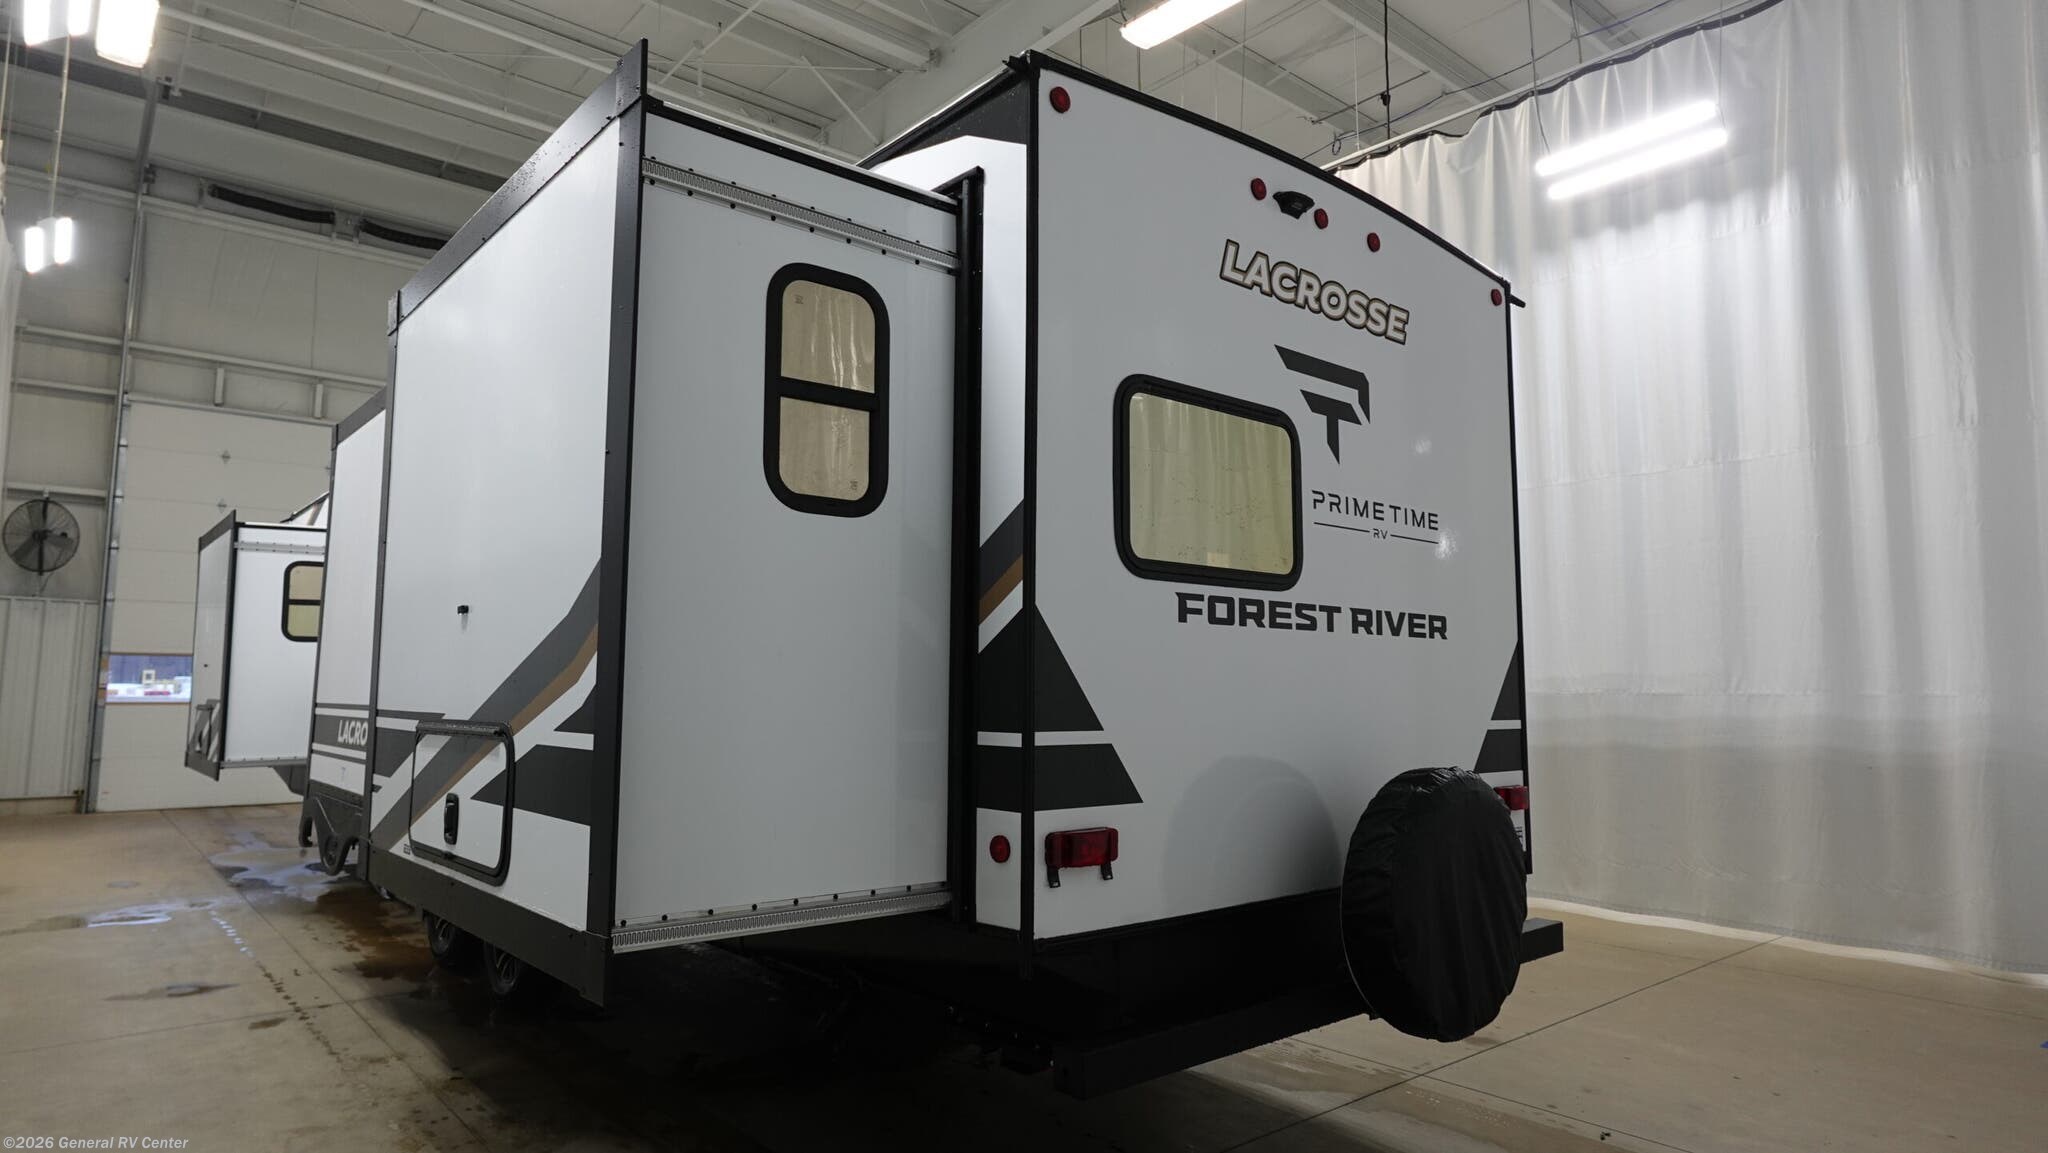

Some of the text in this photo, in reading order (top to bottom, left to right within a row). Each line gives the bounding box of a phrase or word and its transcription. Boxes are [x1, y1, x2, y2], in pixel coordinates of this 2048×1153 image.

[1219, 239, 1410, 345] LACROSSE
[1372, 528, 1388, 540] RV
[1175, 592, 1448, 640] FOREST RIVER
